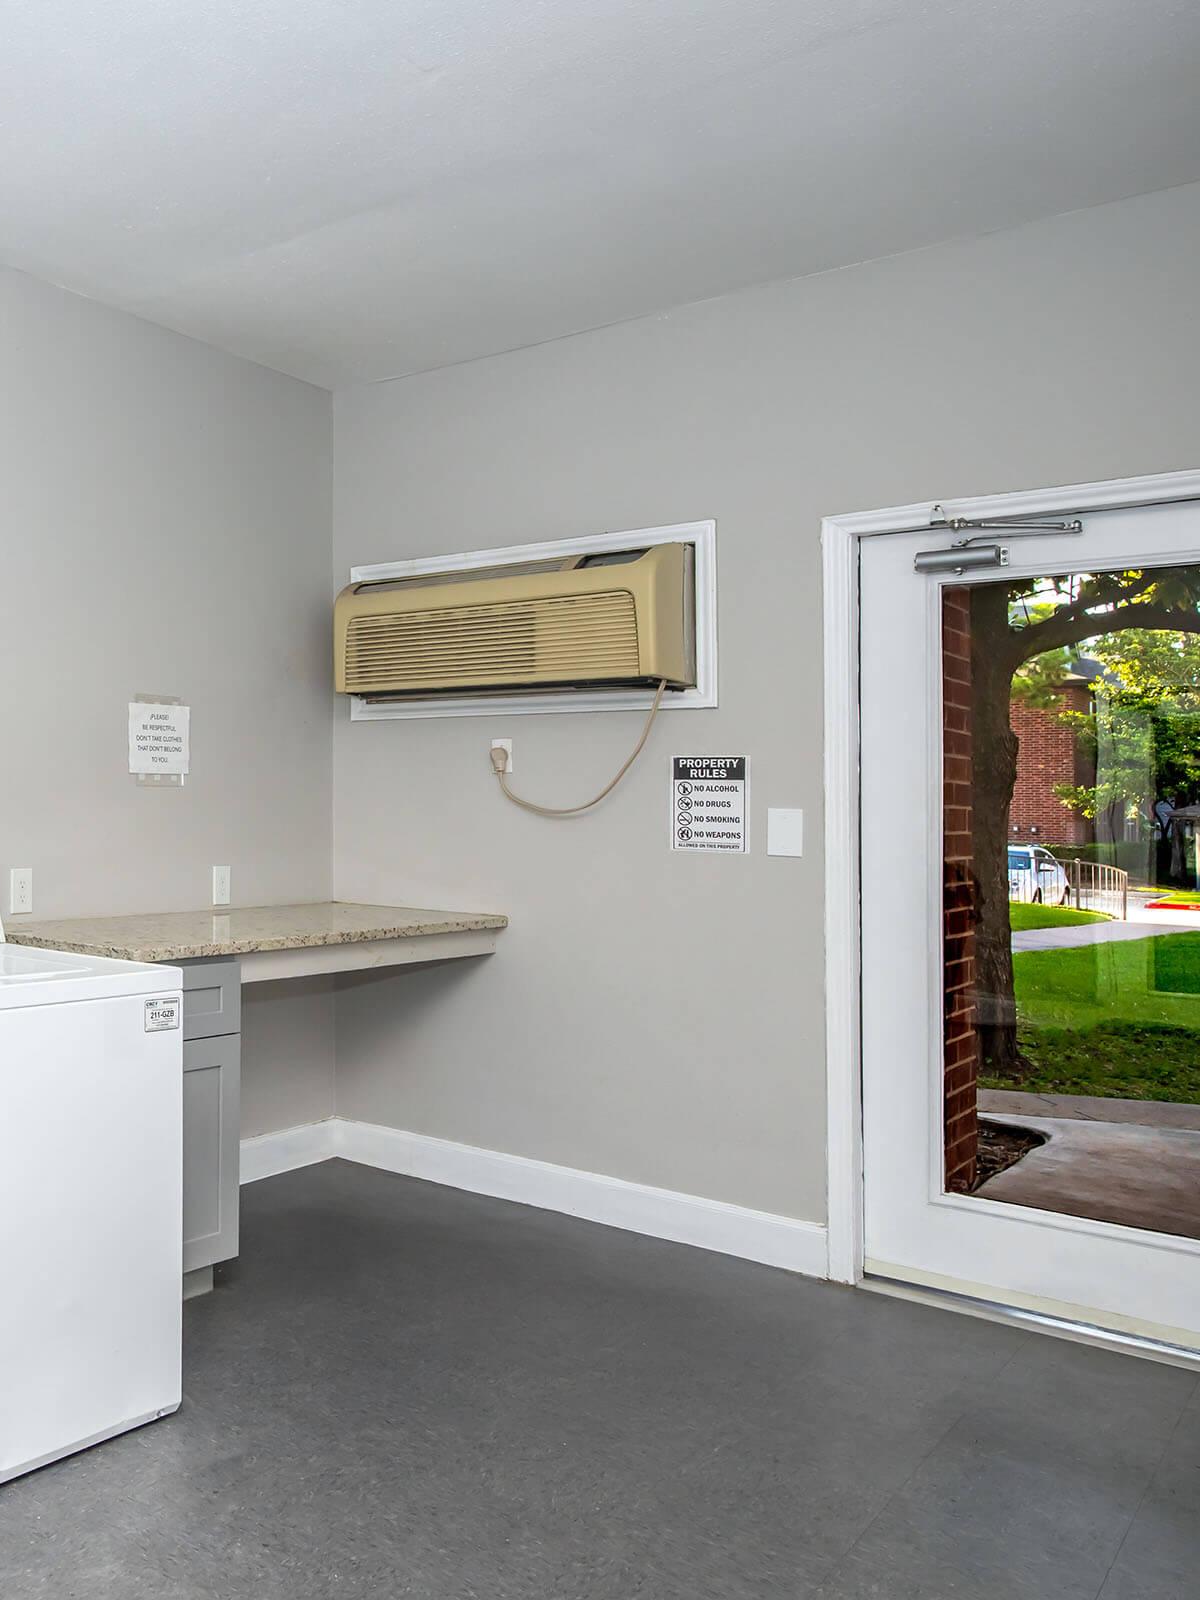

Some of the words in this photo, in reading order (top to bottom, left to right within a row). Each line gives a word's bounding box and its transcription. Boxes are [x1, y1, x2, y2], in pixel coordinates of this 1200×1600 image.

[679, 759, 740, 768] PROPERTY
[690, 769, 728, 778] RULES
[705, 785, 740, 793] ALCOHOL
[705, 831, 742, 839] WEAPONS
